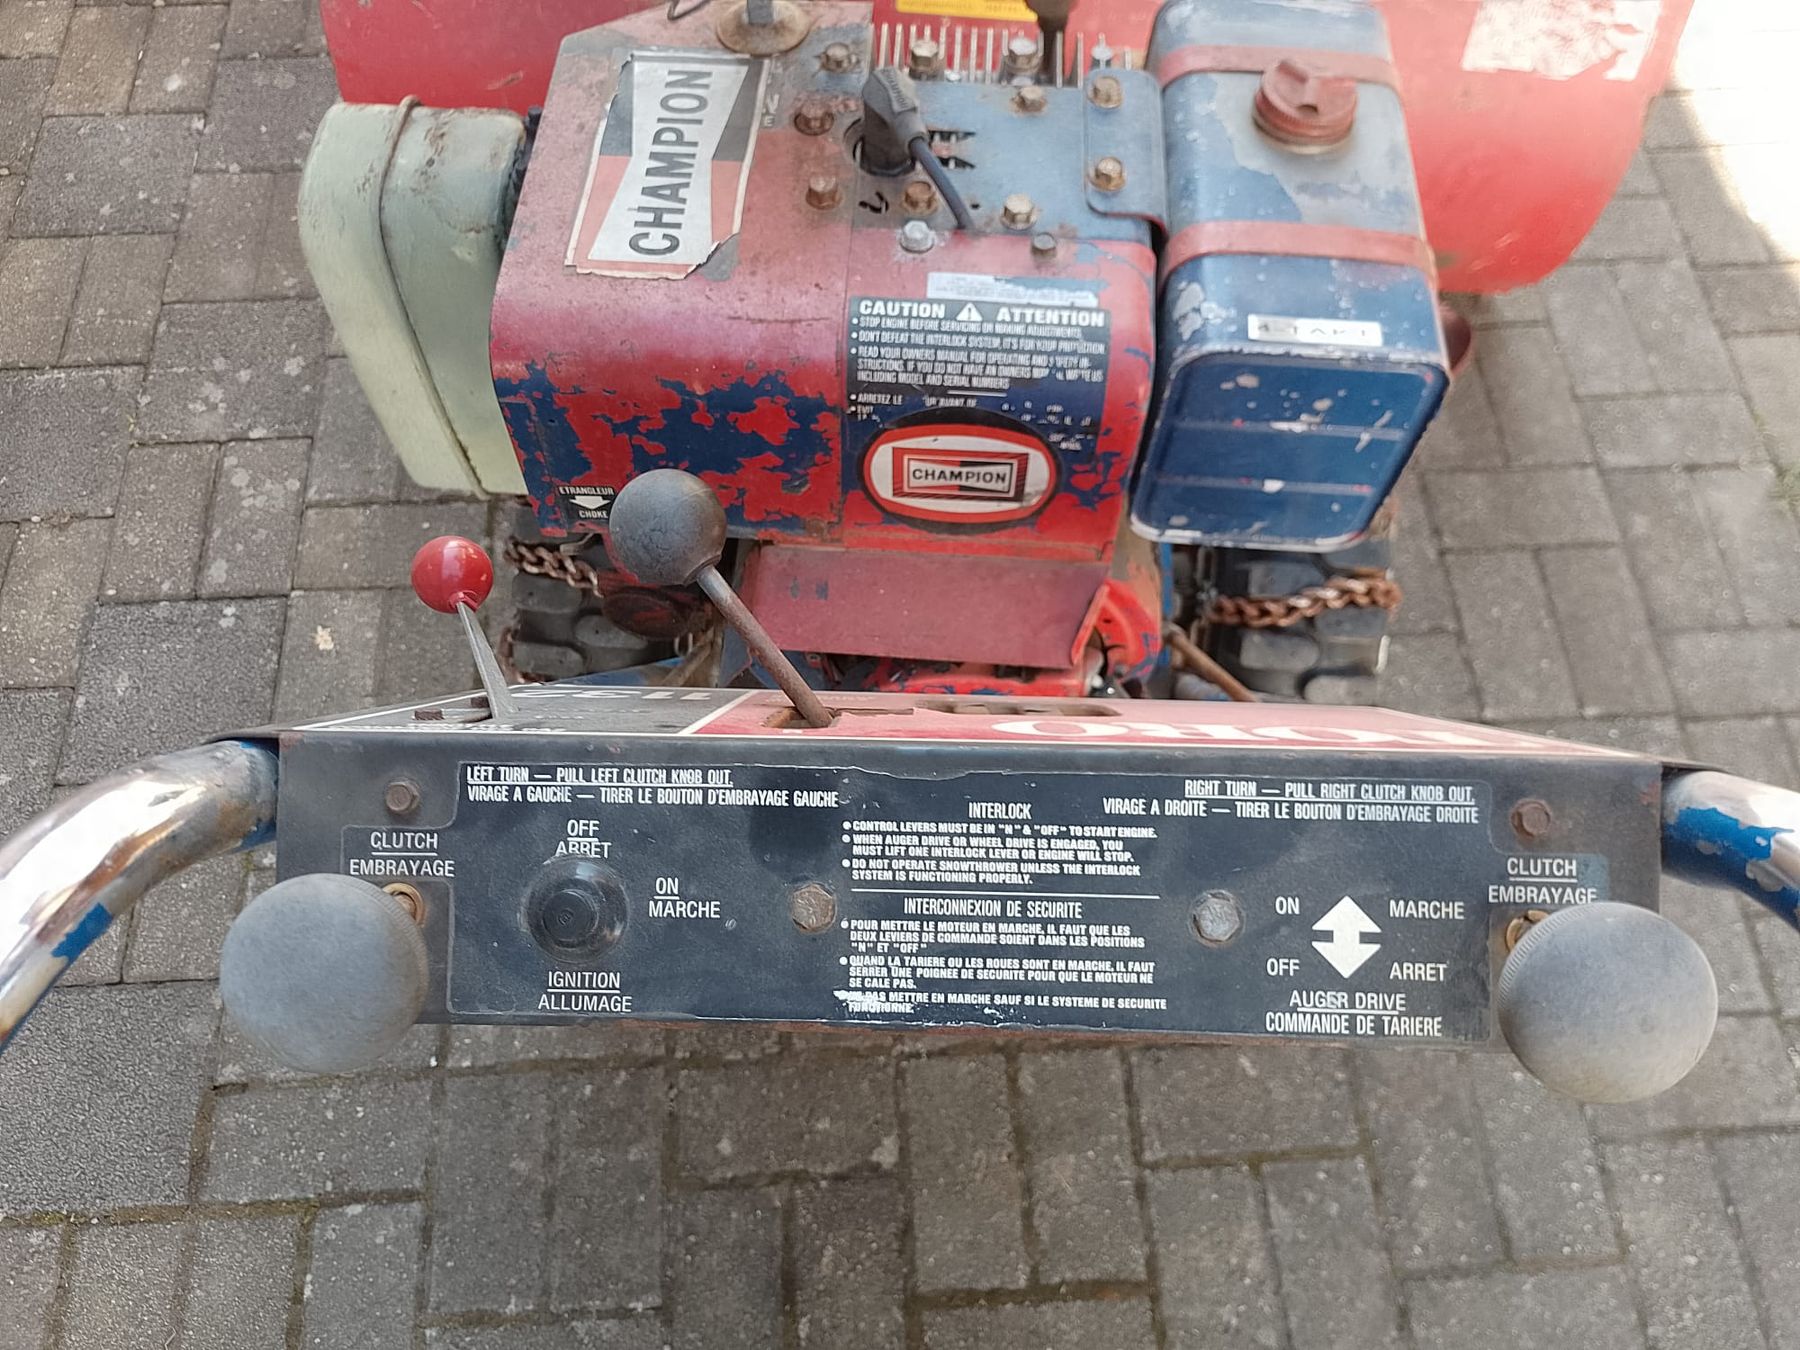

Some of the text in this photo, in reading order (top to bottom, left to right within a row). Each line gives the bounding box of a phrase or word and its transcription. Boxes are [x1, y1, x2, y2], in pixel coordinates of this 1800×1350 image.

[628, 70, 713, 255] CHAMPION
[860, 300, 1105, 327] CAUTION ATTENTION
[859, 316, 939, 331] STOP ENGINE BEFORE
[912, 468, 1007, 483] CHAMPION
[579, 510, 609, 519] CHOKE
[991, 720, 1500, 746] TORO
[467, 767, 733, 786] LEFT TURN PULL LEFT CLUTCH KNOB OUT.
[468, 786, 839, 809] VIRAGE A GAUCHE TIRER LE BOUTON D'EMBRAYAGE GAUCHE
[1185, 779, 1475, 803] RIGHT TURN PULL RIGHT CLUTCH KNOB OUT.
[968, 802, 1032, 820] INTERLOCK
[1103, 798, 1479, 823] VIRAGE A DROITE TIRER LE BOUTON D'EMBRAYAGE DROITE
[567, 819, 599, 837] OFF
[852, 820, 1158, 838] CONTROL LEVERS MUST BE IN START ENGINE.
[370, 832, 438, 849] CLUTCH
[556, 841, 612, 858] ARRET
[852, 834, 883, 844] WHEN
[885, 835, 919, 845] AUGER
[921, 836, 950, 846] DRIVE
[969, 837, 1003, 848] WHEEL
[1005, 838, 1035, 848] DRIVE
[1102, 840, 1123, 851] YOU
[852, 846, 1134, 862] MUST LIFT ONE INTERLOCK LEVER ENGINE WILL STOP.
[350, 860, 455, 877] EMBRAYAGE
[852, 859, 1141, 876] DO NOT OPERATE SNOWTHROWER UNLESS THE INTERLOCK
[1508, 858, 1577, 877] CLUTCH
[655, 877, 679, 895] ON
[852, 870, 1033, 884] SYSTEM IS FUNCTIONING PROPERLY.
[1489, 885, 1597, 904] EMBRAYAGE
[649, 901, 721, 919] MARCHE
[904, 898, 1083, 919] INTERCONNEXION DE SECURITE
[1275, 897, 1300, 915] ON
[1389, 900, 1464, 919] MARCHE
[851, 920, 878, 930] POUR
[881, 920, 921, 931] METTRE
[923, 921, 935, 931] LE
[937, 921, 980, 932] MOTEUR
[1059, 924, 1087, 935] FAUT
[1089, 925, 1110, 937] QUE
[1111, 926, 1130, 936] LES
[851, 931, 1145, 948] DEUX LEVIERS DE COMMANDE SOIENT DANS LES POSITIONS
[849, 956, 885, 967] QUAND
[888, 956, 901, 966] LA
[904, 957, 946, 968] TARIERE
[965, 957, 984, 968] LES
[986, 958, 1019, 970] ROUES
[1022, 959, 1050, 970] SONT
[1128, 961, 1155, 972] FAUT
[1266, 958, 1300, 976] OFF
[1389, 962, 1446, 981] ARRET
[548, 971, 621, 989] IGNITION
[849, 967, 1137, 983] SERRER UNE POIGNEE SECURITE POUR QUE MOTEUR
[864, 978, 917, 989] CALE PAS.
[538, 996, 632, 1013] ALLUMAGE
[889, 992, 928, 1002] METTRE
[947, 993, 991, 1004] MARCHE
[994, 994, 1022, 1005] SAUF
[1051, 996, 1099, 1008] SYSTEME
[1117, 998, 1167, 1010] SECURITE
[1289, 991, 1406, 1011] AUGER DRIVE
[1265, 1013, 1442, 1037] COMMANDE DE TARIERE
